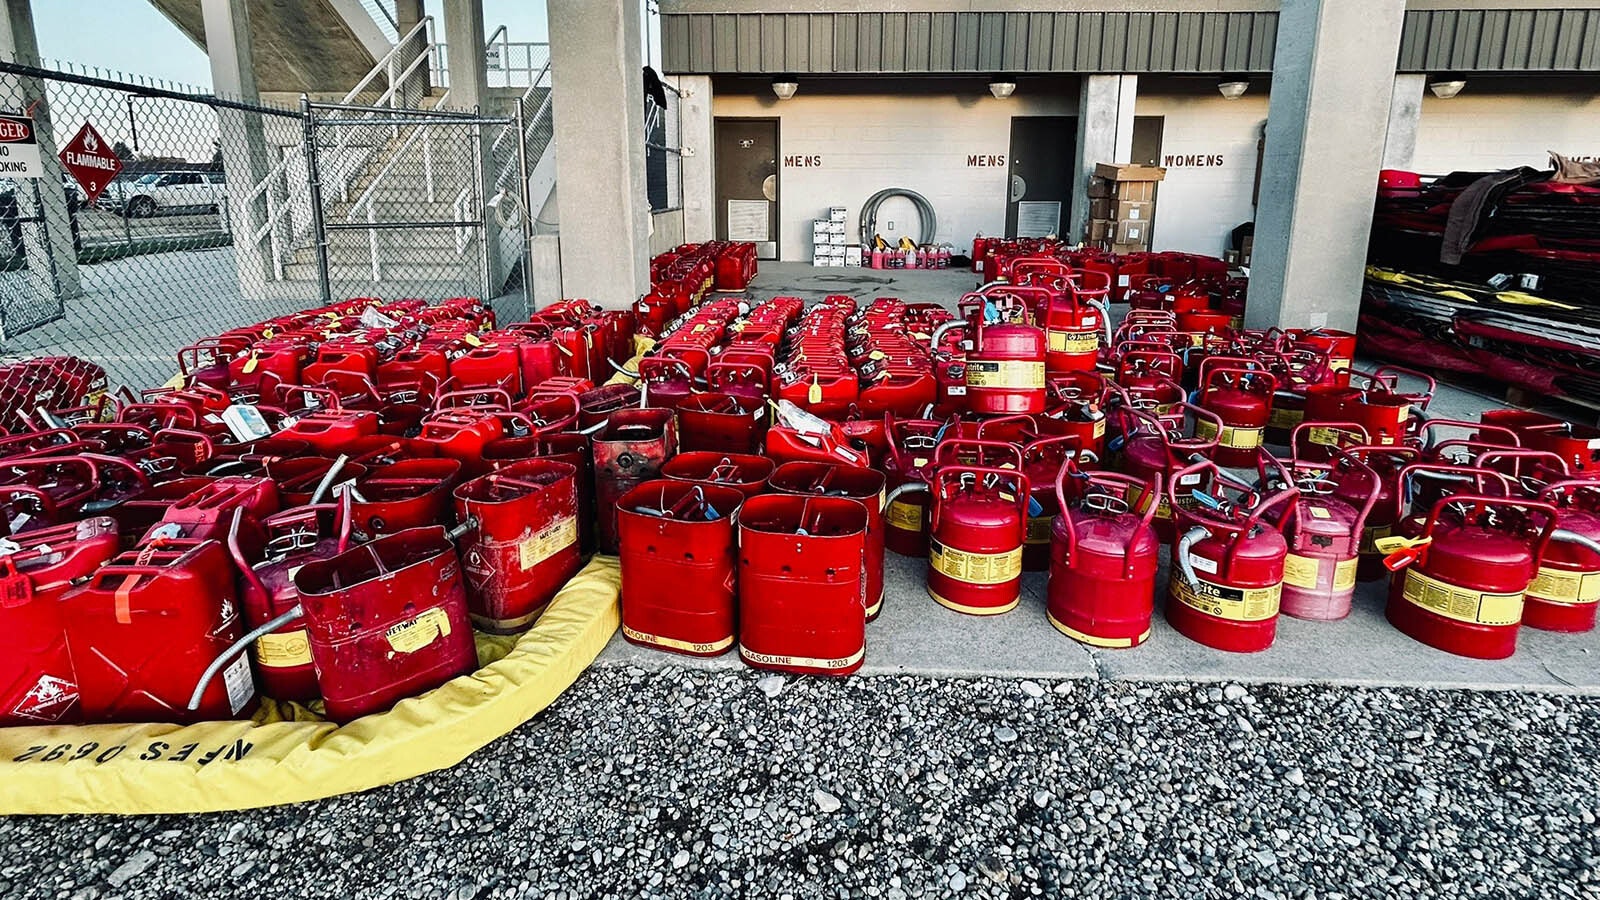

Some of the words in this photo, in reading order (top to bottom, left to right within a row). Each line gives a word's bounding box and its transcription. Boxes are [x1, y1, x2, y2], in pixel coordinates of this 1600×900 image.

[0, 122, 25, 138] GER
[66, 151, 116, 171] FLAMMABLE
[784, 155, 821, 167] MENS
[967, 155, 1005, 167] MENS
[1164, 154, 1224, 167] WOMENS
[90, 181, 97, 191] 3
[623, 625, 657, 643] GASOLINE
[692, 644, 714, 652] 1203
[744, 650, 792, 664] GASOLINE
[827, 658, 848, 668] 1203
[13, 741, 126, 766] 0692
[140, 738, 253, 766] NFES
